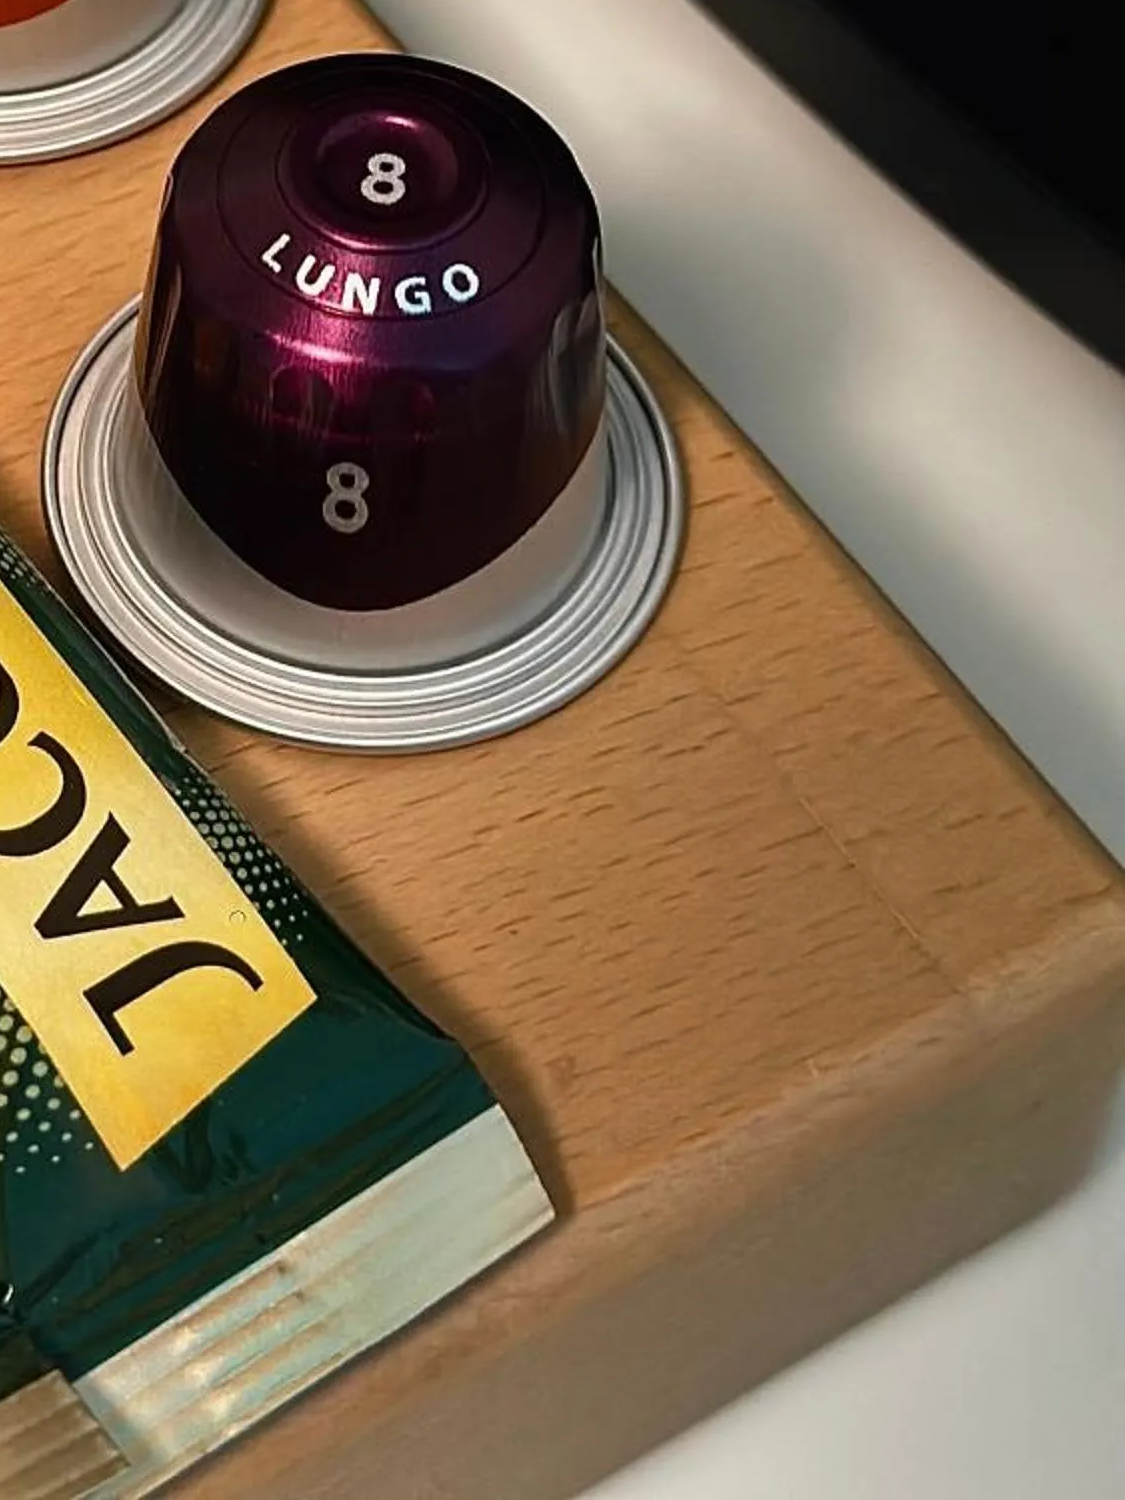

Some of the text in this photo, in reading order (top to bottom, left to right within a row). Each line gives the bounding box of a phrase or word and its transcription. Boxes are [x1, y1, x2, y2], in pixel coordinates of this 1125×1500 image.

[360, 152, 407, 205] 8
[260, 233, 480, 316] LUNGO
[321, 462, 371, 534] 8
